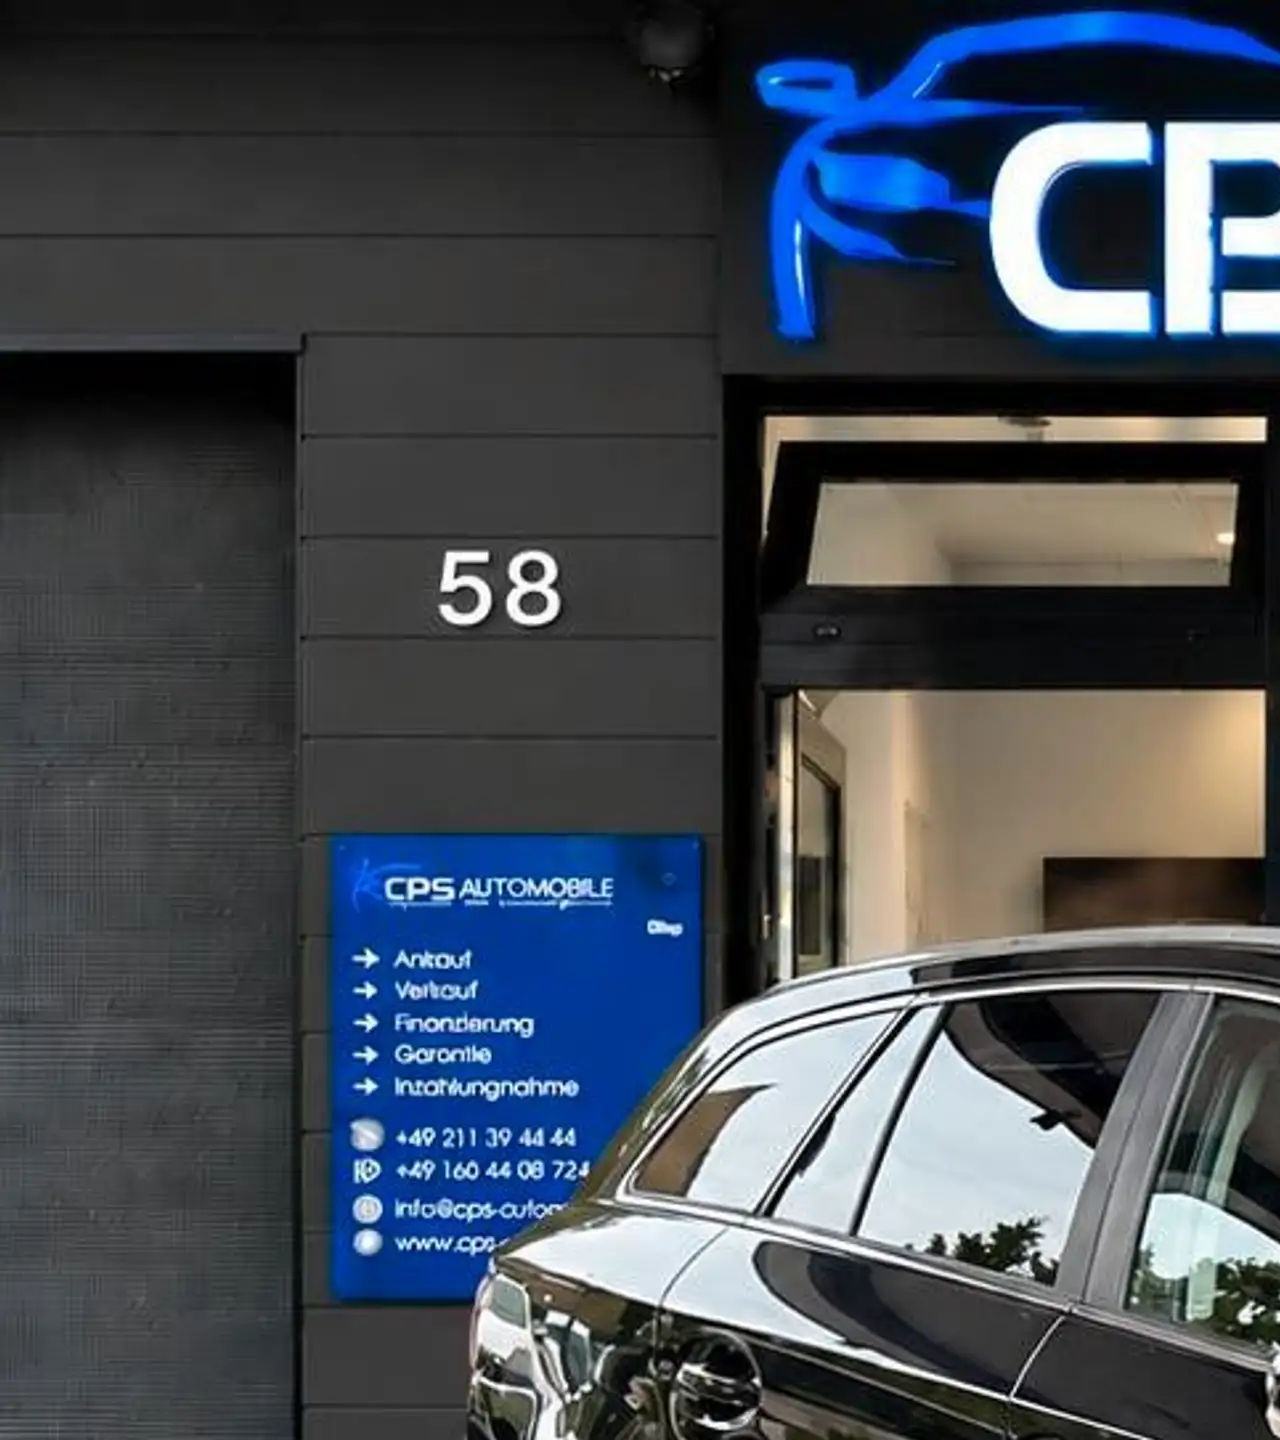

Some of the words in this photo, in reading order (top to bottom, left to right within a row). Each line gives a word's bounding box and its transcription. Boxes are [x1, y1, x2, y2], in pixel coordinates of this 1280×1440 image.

[438, 550, 561, 626] 58
[384, 876, 456, 901] CPS
[458, 877, 614, 899] AUTOMOBILE
[393, 949, 472, 969] Ankauf
[394, 980, 479, 1000] Verkauf
[394, 1012, 534, 1038] Finanzierung
[394, 1044, 492, 1064] Garantie
[394, 1076, 580, 1102] Inzahlungnahme
[396, 1127, 436, 1147] +49
[442, 1127, 477, 1148] 211
[485, 1127, 512, 1148] 39
[518, 1127, 545, 1147] 44
[549, 1127, 577, 1147] 44
[396, 1159, 436, 1181] +49
[444, 1160, 480, 1180] 160
[485, 1160, 512, 1179] 44
[517, 1160, 545, 1180] 08
